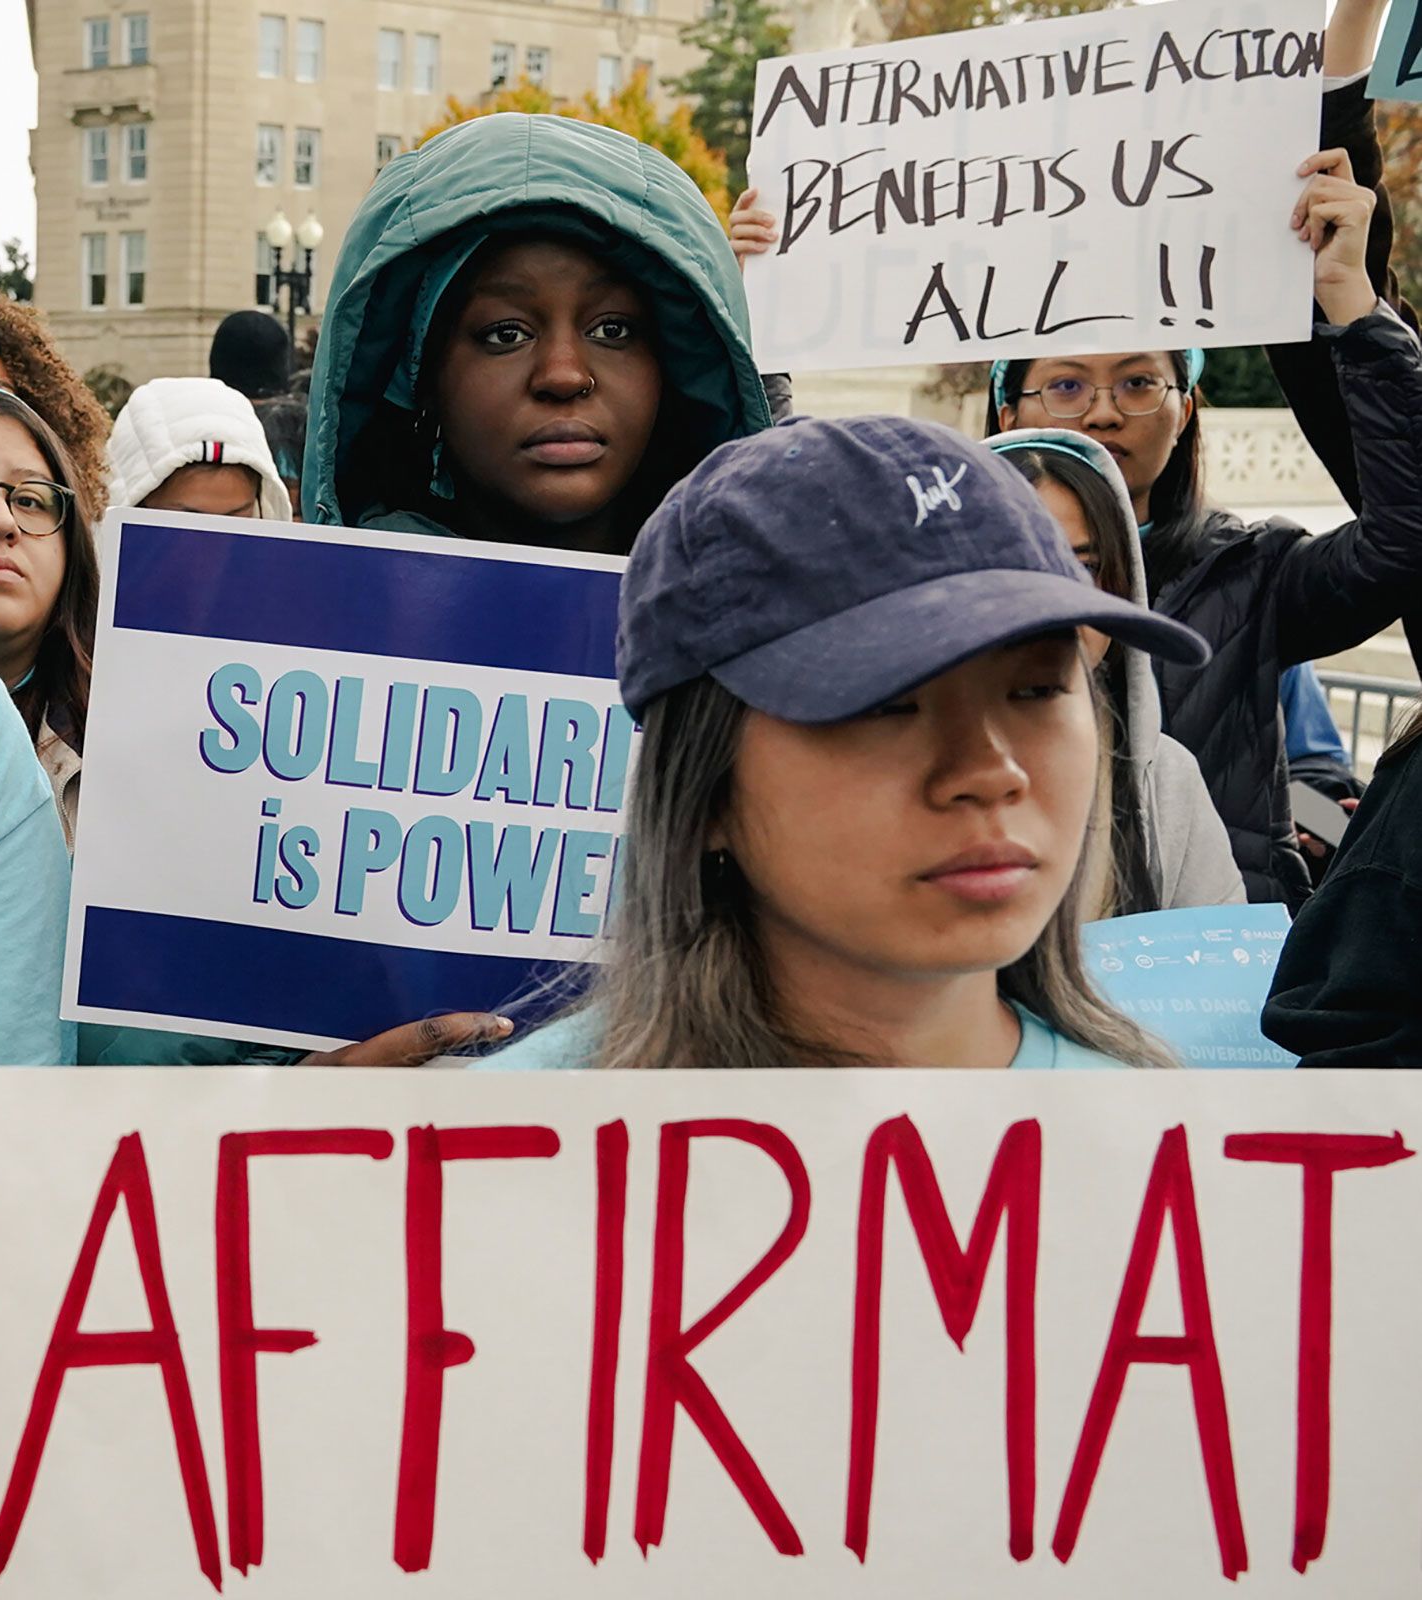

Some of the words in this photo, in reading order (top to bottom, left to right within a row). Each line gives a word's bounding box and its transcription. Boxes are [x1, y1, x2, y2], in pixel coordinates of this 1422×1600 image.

[756, 39, 1134, 137] AFFIRMATIVE
[1145, 28, 1326, 94] ACTION
[776, 147, 1086, 256] BENEFITS
[1112, 134, 1215, 208] US
[903, 260, 1134, 345] ALL
[1158, 242, 1216, 329] !!
[198, 661, 642, 814] SOLIDARI
[252, 797, 321, 909] is
